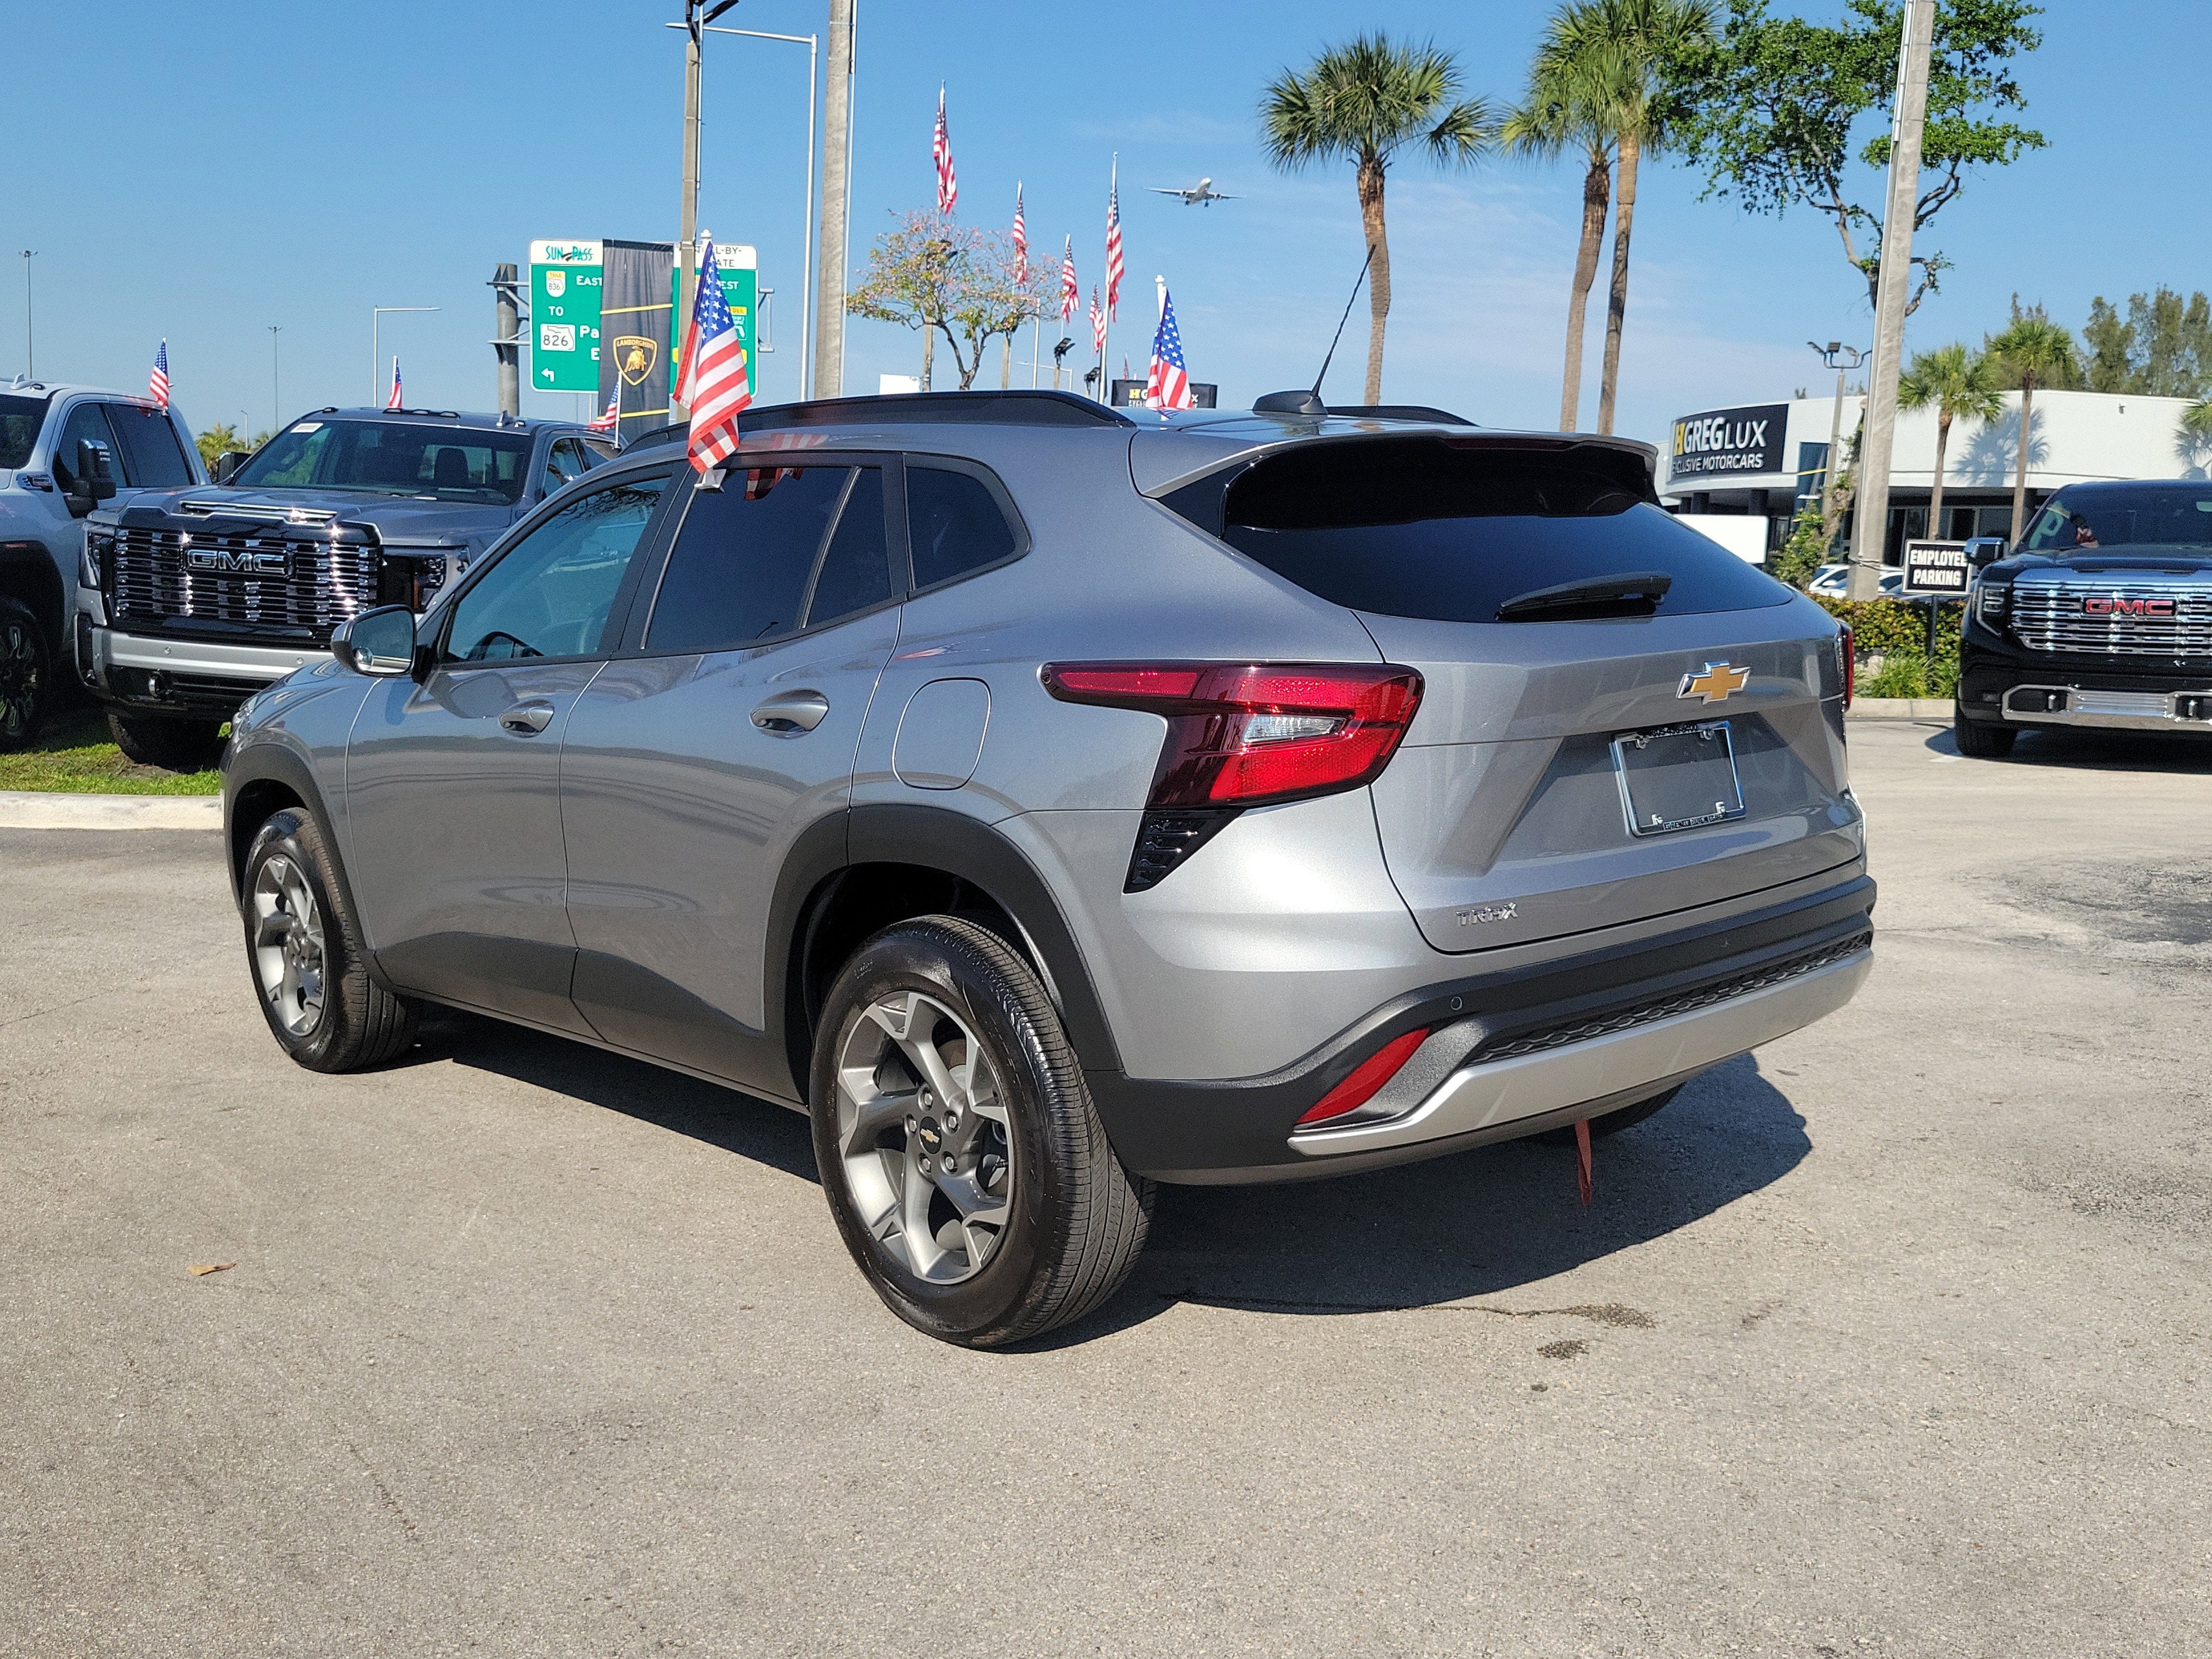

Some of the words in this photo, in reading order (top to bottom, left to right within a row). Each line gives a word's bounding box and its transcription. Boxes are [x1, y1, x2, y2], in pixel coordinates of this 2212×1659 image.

[720, 281, 739, 290] EST
[548, 306, 564, 317] TO
[543, 335, 568, 346] 826
[616, 339, 654, 351] LAMBORGHINI
[1702, 453, 1764, 470] MOTORCARS
[187, 549, 285, 574] GMC
[1910, 549, 1967, 567] EMPLOYEE
[1912, 569, 1961, 586] PARKING
[2085, 599, 2173, 616] GMC
[1455, 902, 1518, 926] TRAX
